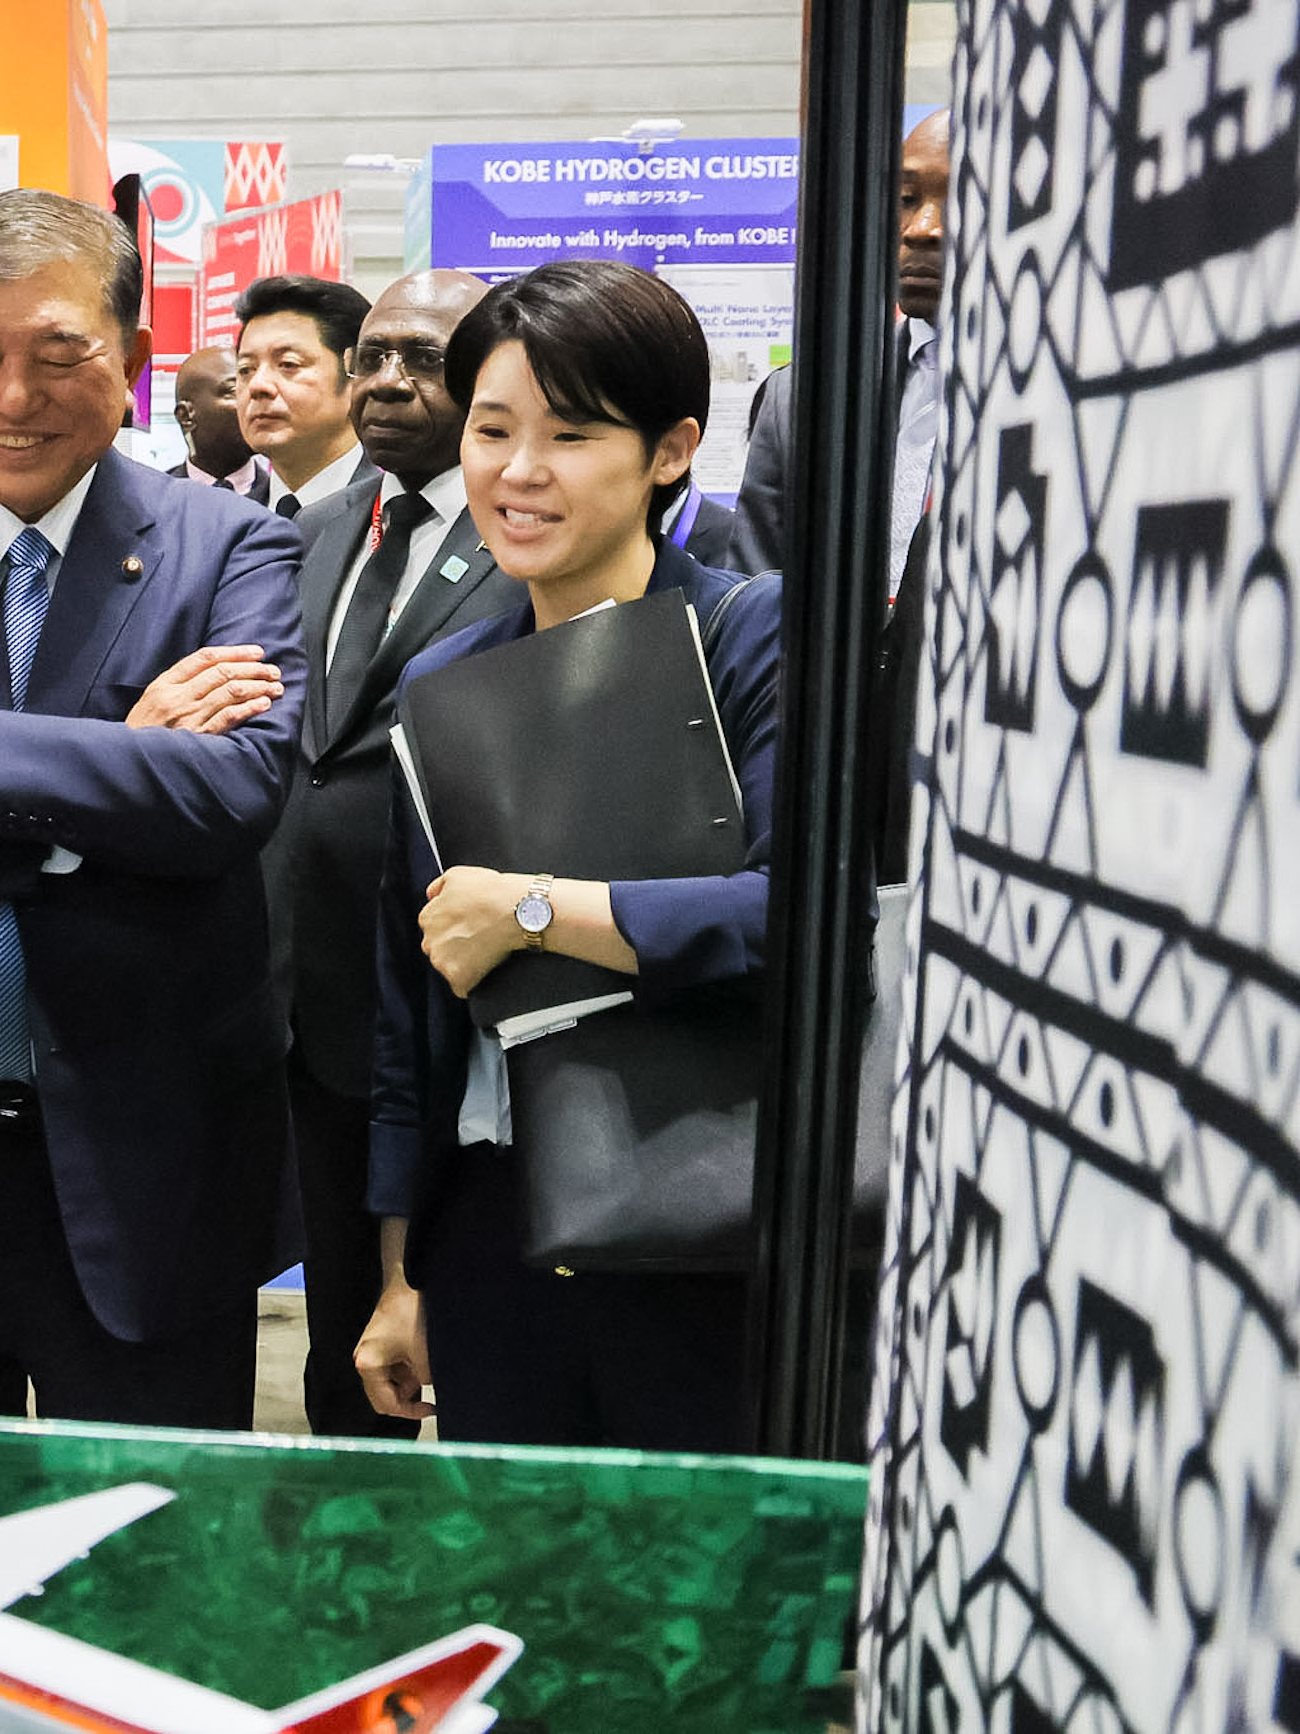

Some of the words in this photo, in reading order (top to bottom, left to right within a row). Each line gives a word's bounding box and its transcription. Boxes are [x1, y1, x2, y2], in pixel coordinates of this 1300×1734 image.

[483, 160, 550, 183] KOBE
[555, 157, 700, 182] HYDROGEN
[490, 231, 561, 249] Innovate
[565, 230, 600, 247] with
[603, 228, 691, 250] Hydrogen,
[695, 227, 735, 245] from
[738, 227, 789, 245] KOBE
